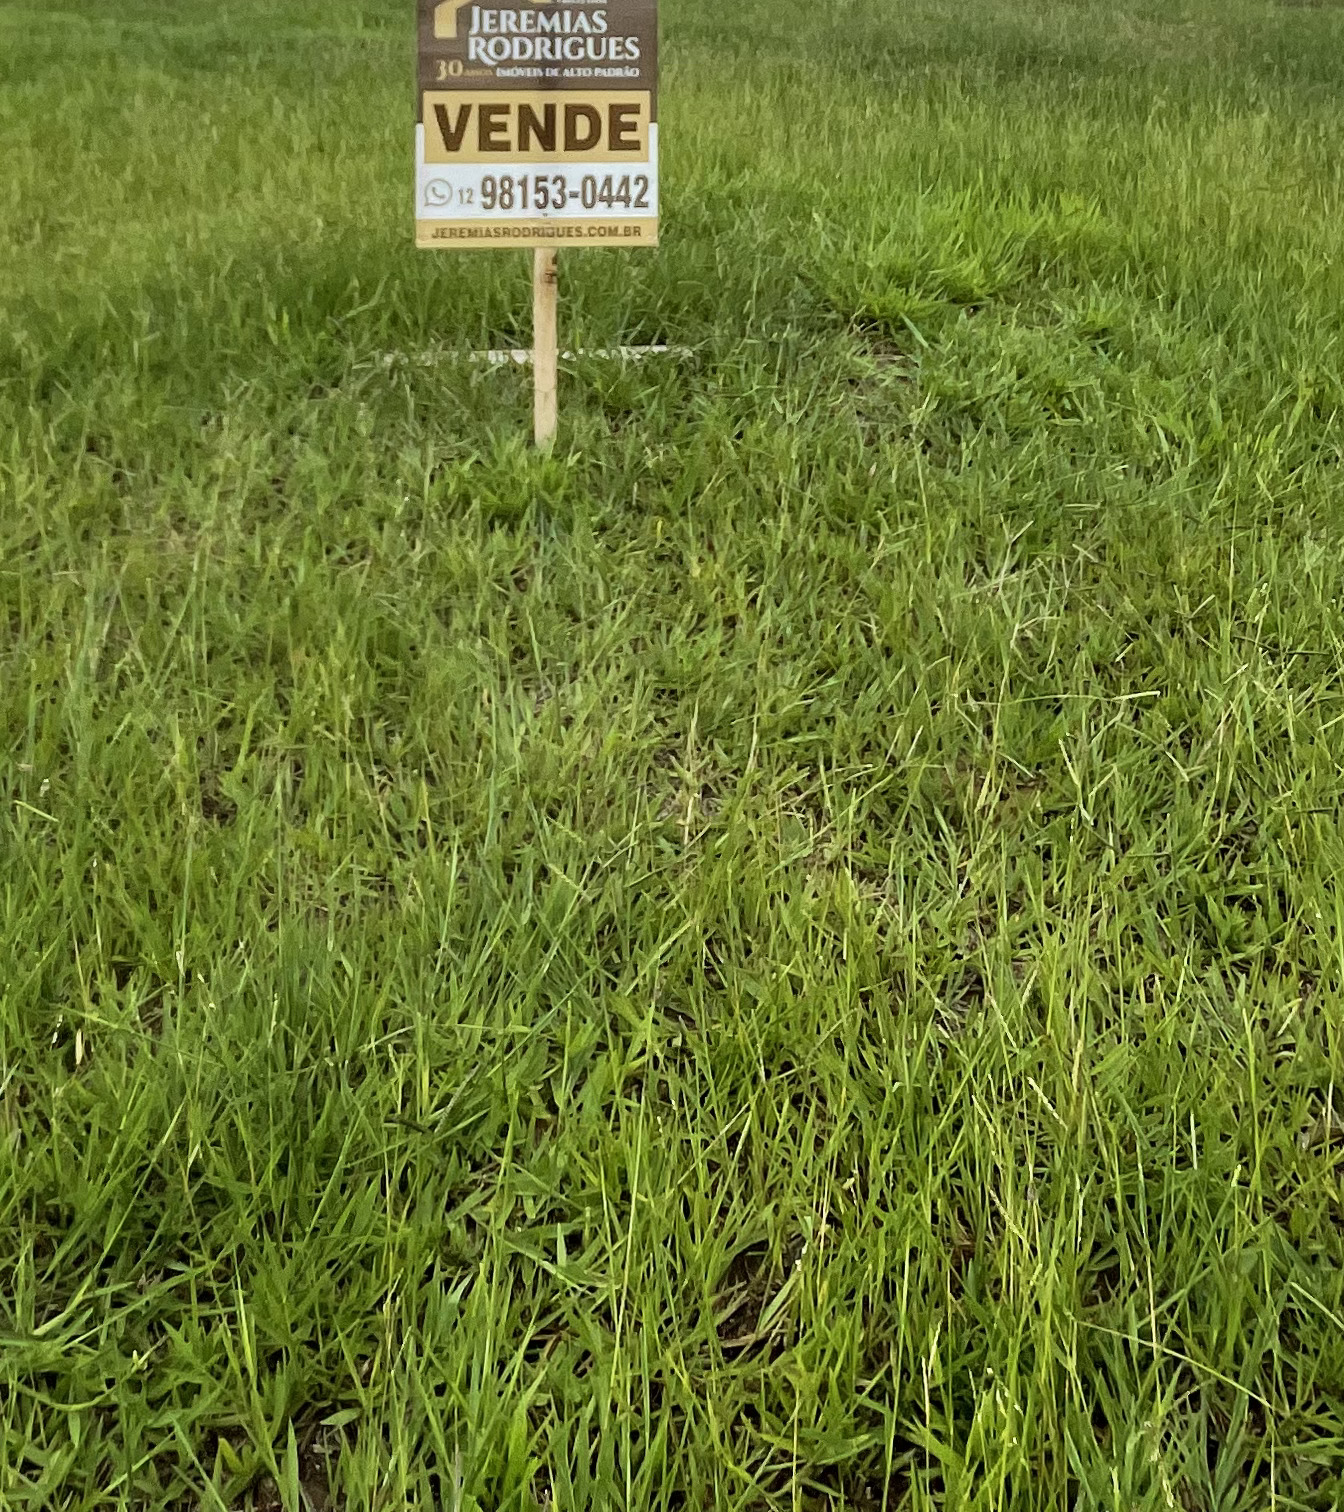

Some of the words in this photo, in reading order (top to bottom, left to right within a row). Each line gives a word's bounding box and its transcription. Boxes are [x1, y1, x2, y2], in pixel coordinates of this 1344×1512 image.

[468, 6, 607, 34] JEREMIAS
[467, 36, 640, 65] RODRIGUES
[435, 59, 463, 81] 30
[562, 67, 592, 77] ALTO
[433, 103, 641, 152] VENDE
[458, 187, 473, 205] 12
[480, 174, 649, 210] 98153-0442
[431, 225, 642, 239] JEREMIASRODRIGUES.COM.BR
